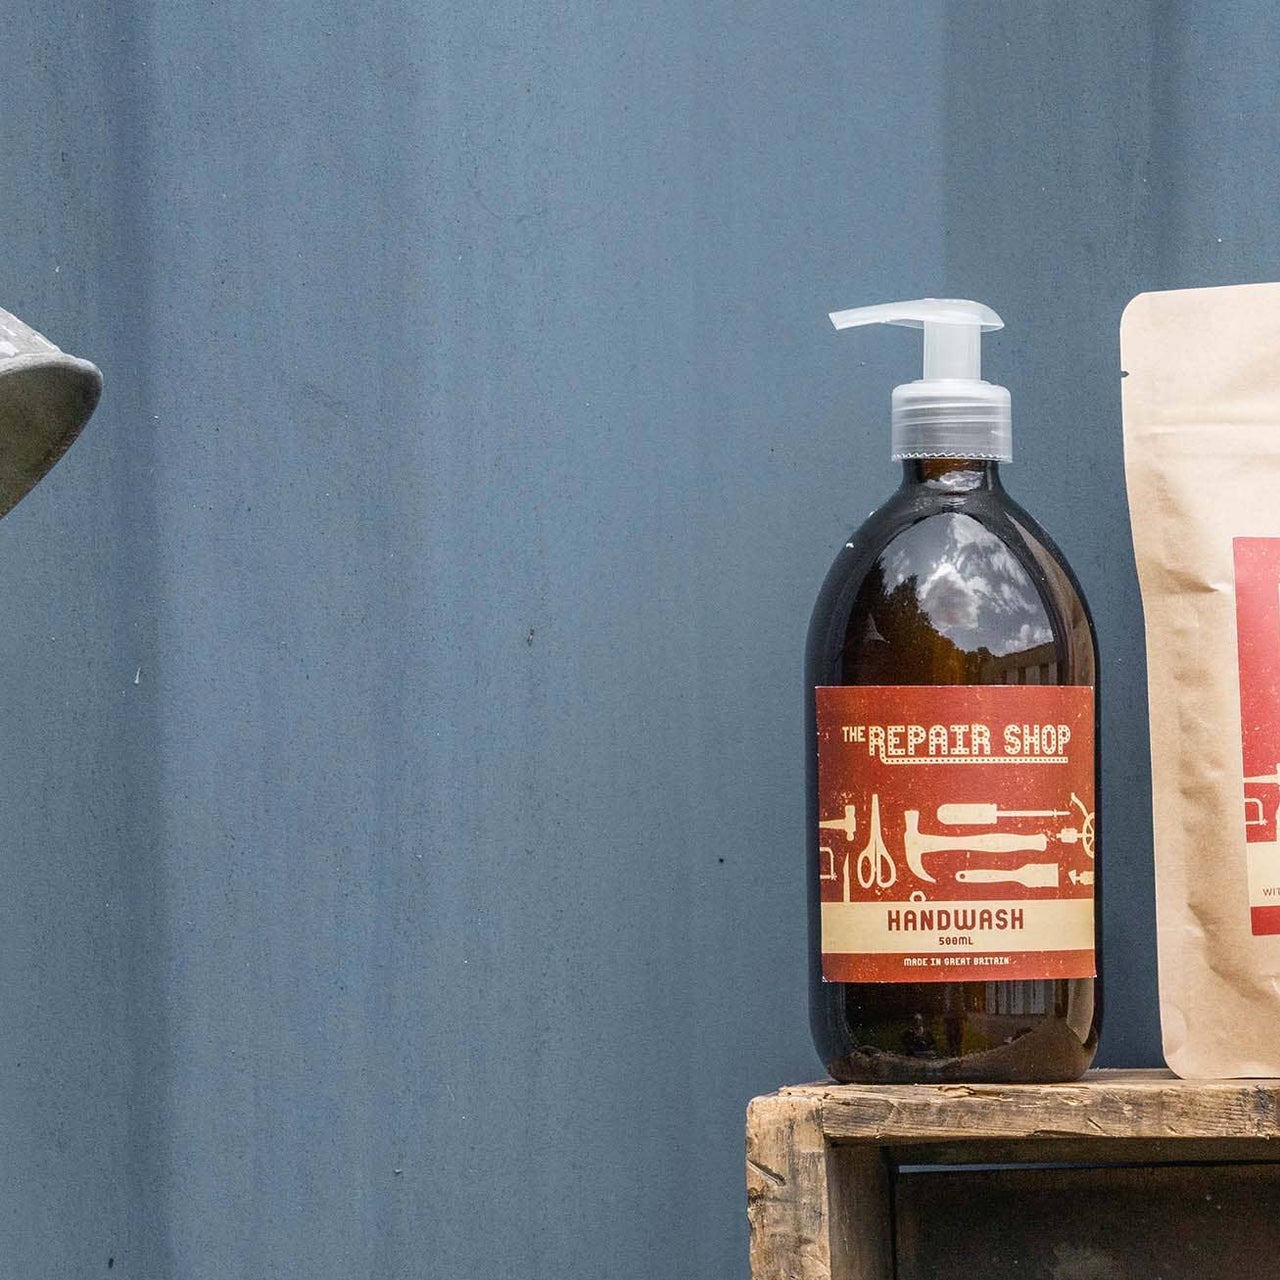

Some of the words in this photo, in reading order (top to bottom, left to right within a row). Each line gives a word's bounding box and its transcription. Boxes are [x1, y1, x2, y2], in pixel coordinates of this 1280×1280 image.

[842, 726, 866, 743] THE
[869, 725, 991, 756] REPAIR
[1003, 725, 1071, 755] SHOP
[888, 909, 1024, 931] HANDWASH
[939, 936, 974, 946] 500ML
[903, 958, 928, 966] MADE
[930, 957, 941, 966] IN
[944, 957, 971, 966] GREAT
[973, 956, 1009, 965] BRITAIN
